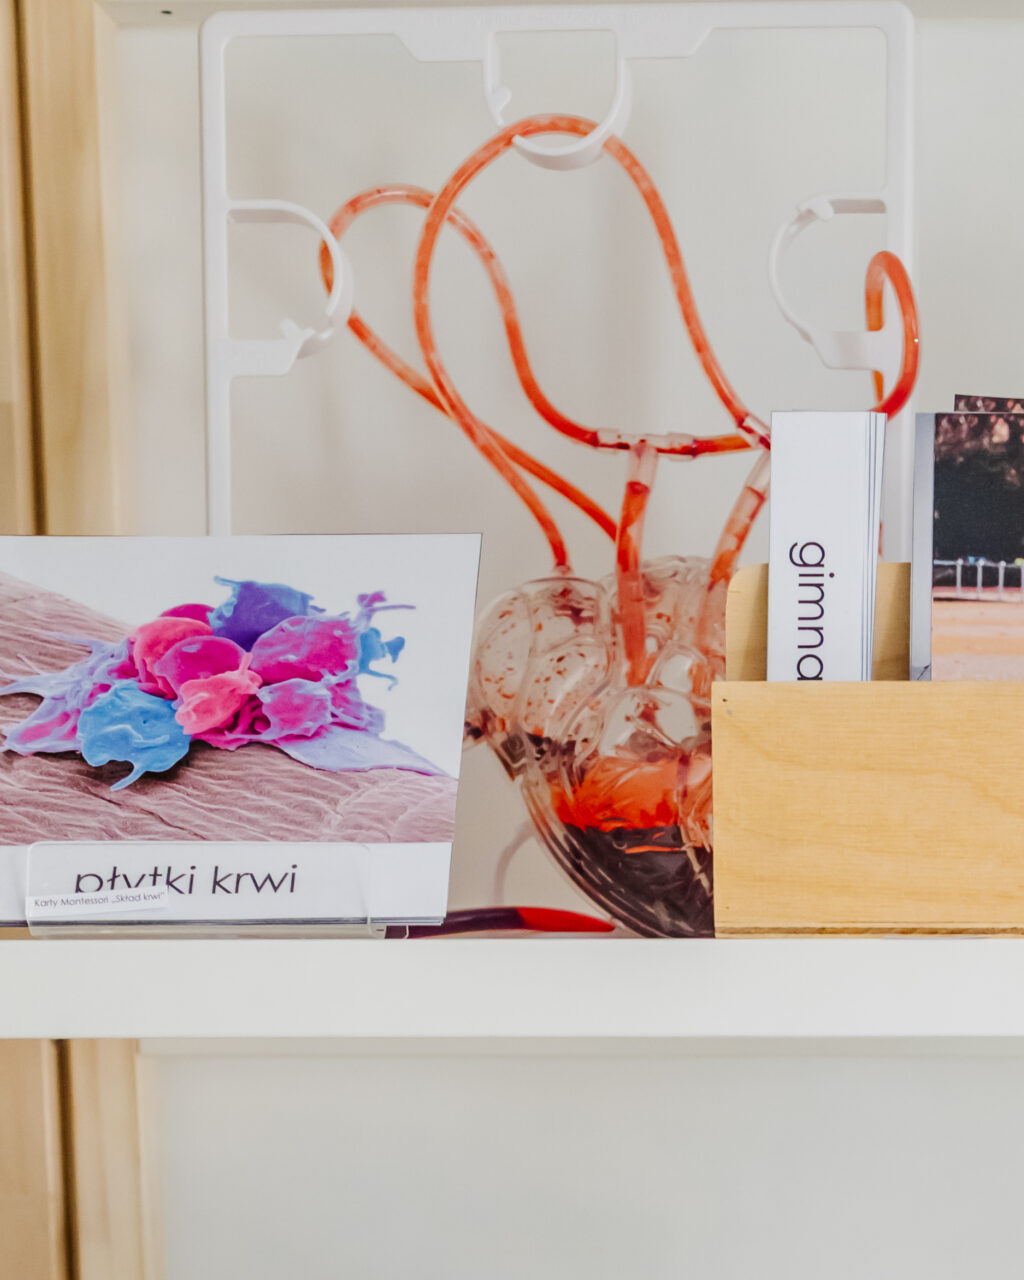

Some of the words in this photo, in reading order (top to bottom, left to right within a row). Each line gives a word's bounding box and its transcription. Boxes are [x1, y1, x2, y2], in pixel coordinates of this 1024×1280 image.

[788, 540, 836, 681] gimna
[211, 863, 299, 895] krwi
[34, 898, 58, 908] Karty
[60, 895, 109, 906] Montessori
